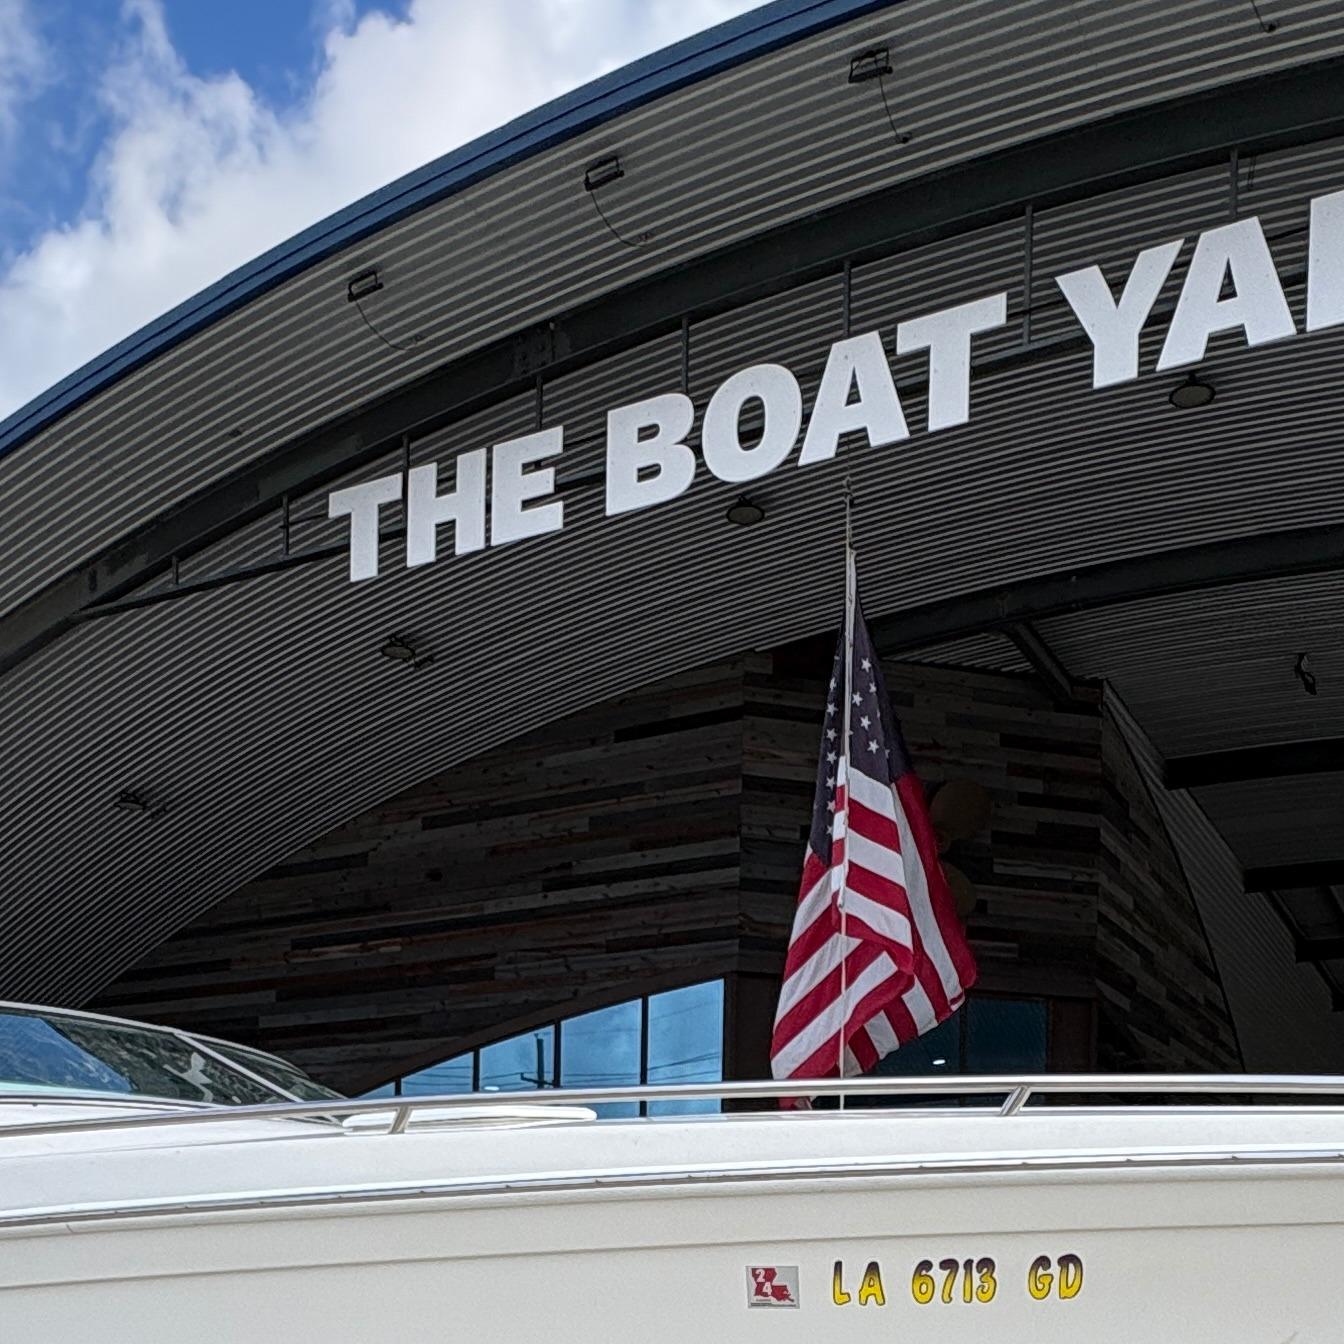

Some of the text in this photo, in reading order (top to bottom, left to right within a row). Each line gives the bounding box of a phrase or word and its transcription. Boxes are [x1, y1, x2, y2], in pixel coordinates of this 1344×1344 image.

[328, 425, 564, 583] THE
[605, 292, 1008, 517] BOAT
[832, 1253, 1084, 1307] LA 6713 GD
